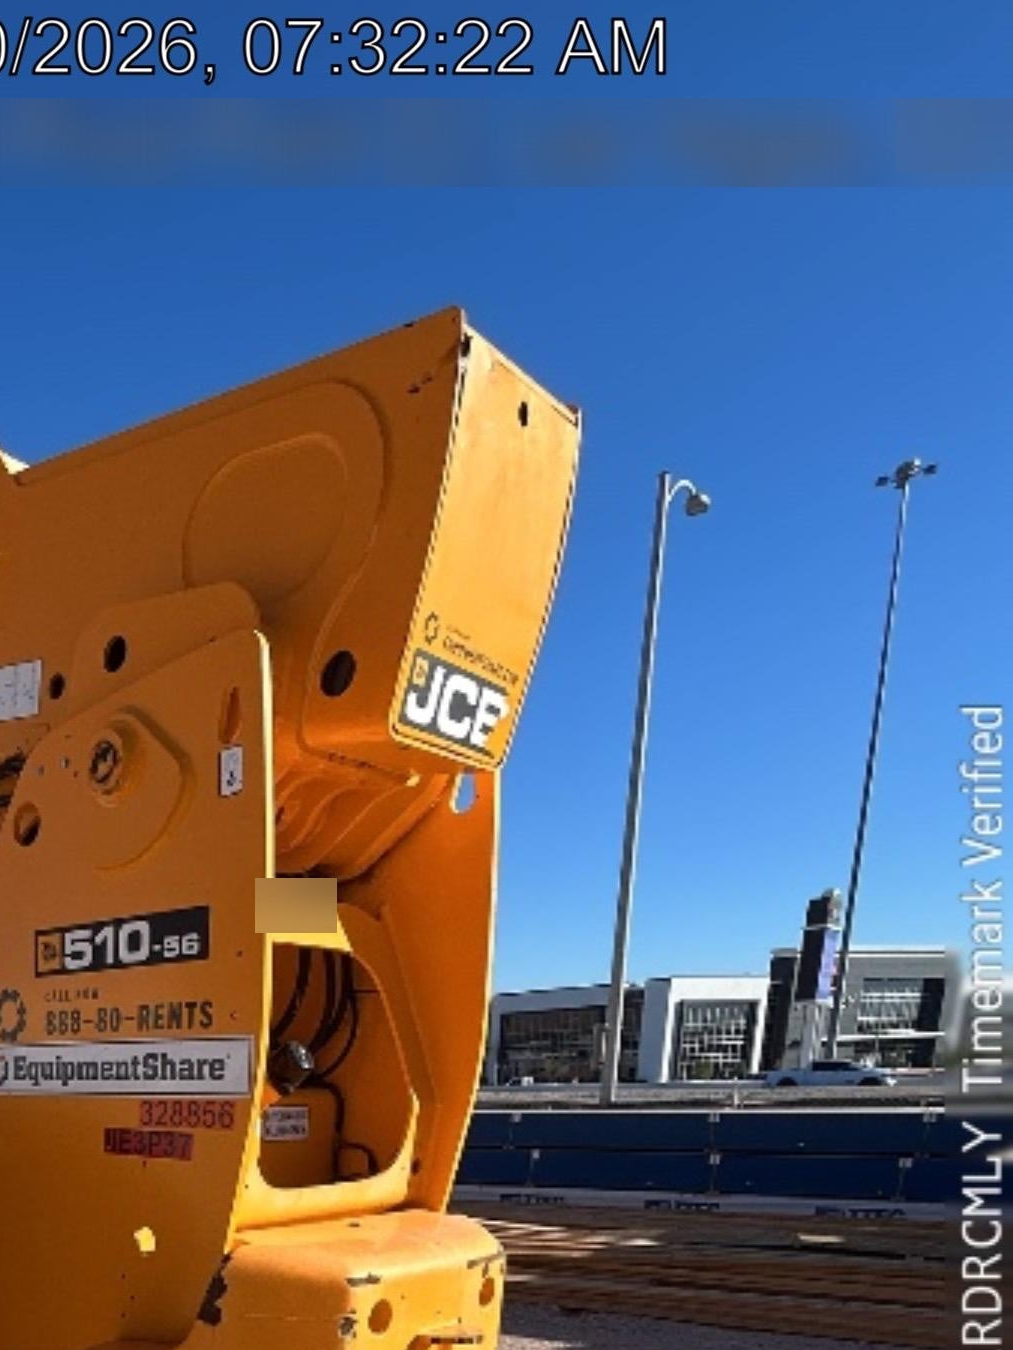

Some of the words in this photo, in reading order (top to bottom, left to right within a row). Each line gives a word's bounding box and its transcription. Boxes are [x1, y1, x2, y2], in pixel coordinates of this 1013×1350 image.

[404, 665, 510, 748] JCB
[64, 921, 200, 970] 510-56
[13, 1052, 226, 1086] EquipmentShare
